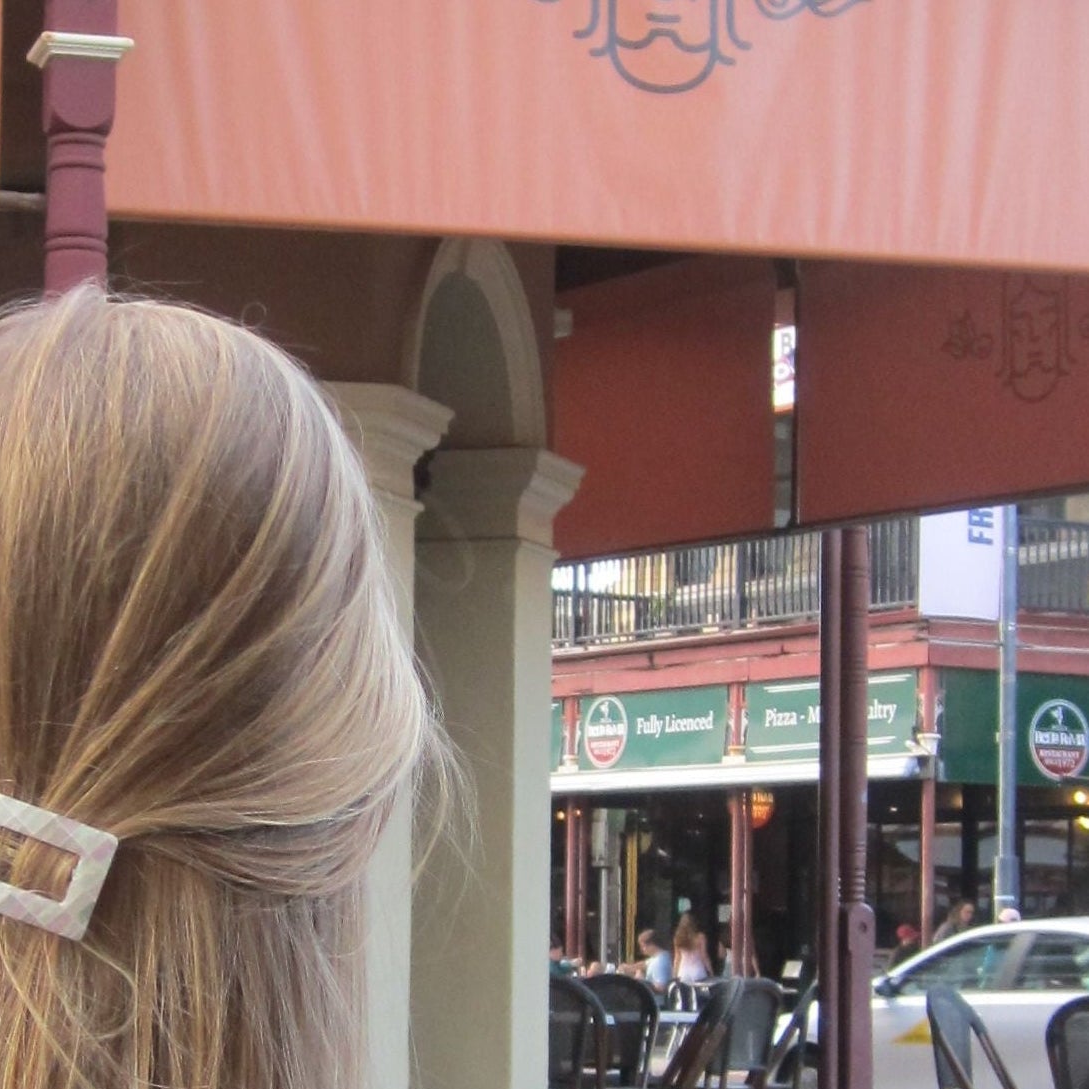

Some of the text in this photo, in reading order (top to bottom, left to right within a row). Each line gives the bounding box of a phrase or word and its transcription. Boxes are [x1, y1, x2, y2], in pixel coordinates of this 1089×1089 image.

[636, 714, 663, 738] Fully
[665, 710, 713, 733] Licenced
[765, 708, 797, 727] Pizza
